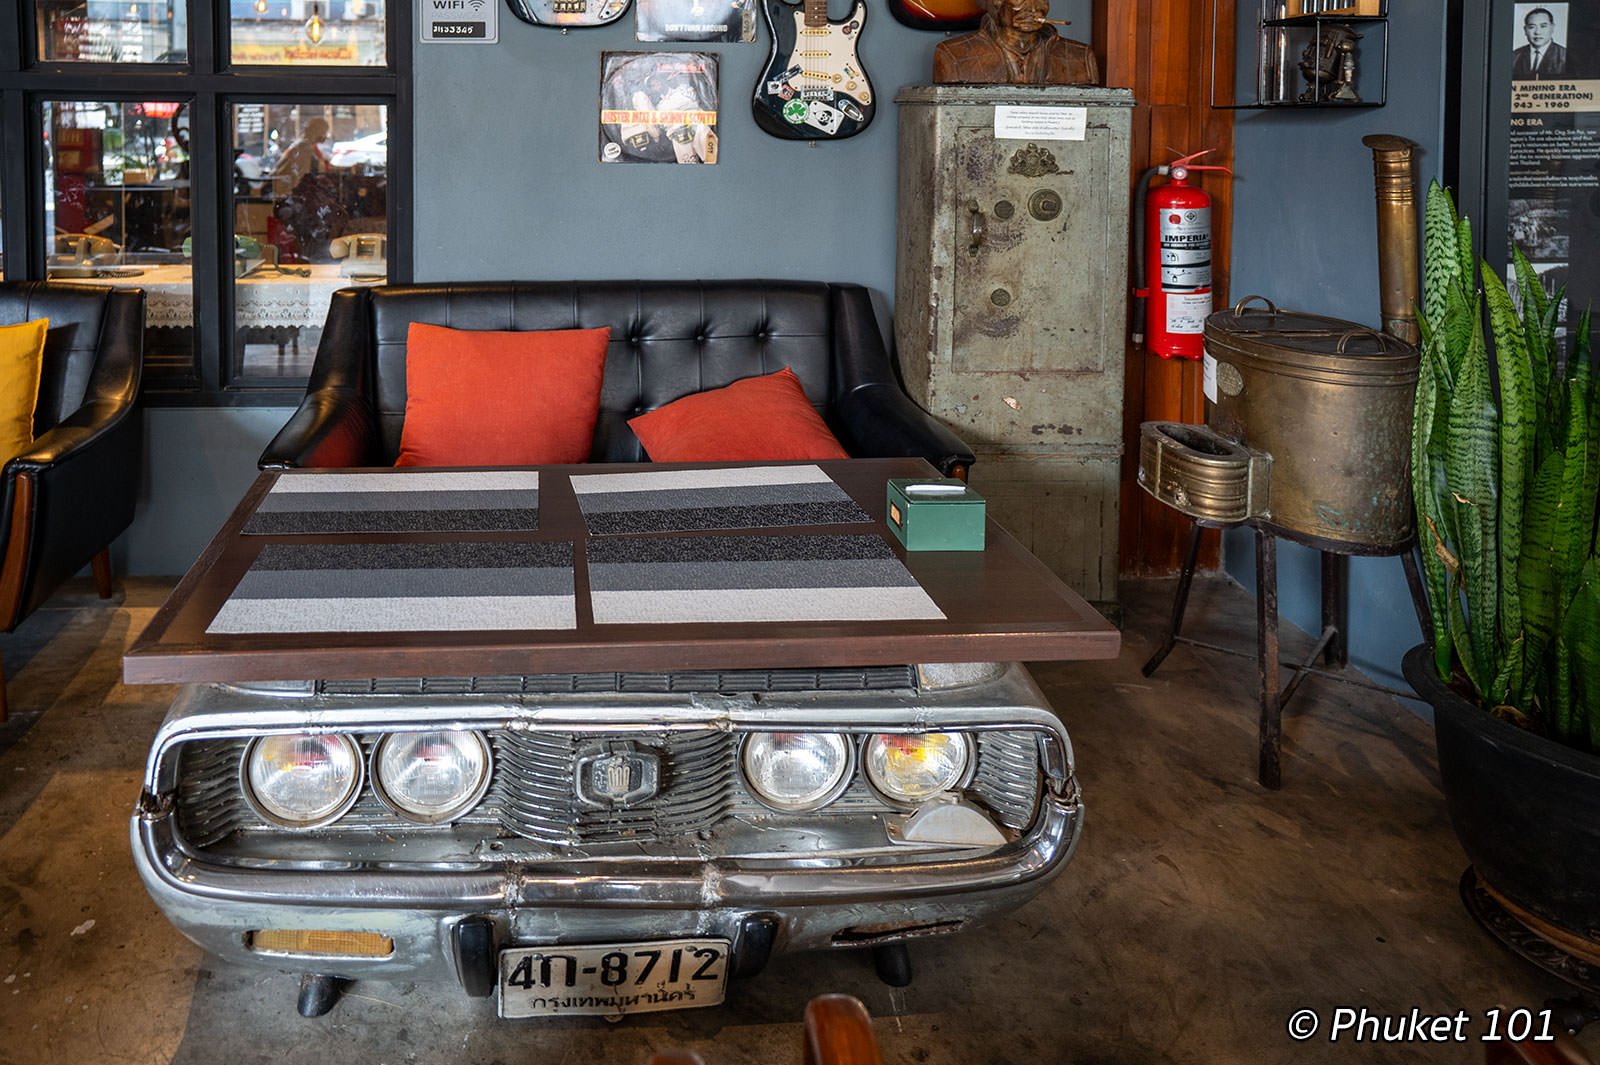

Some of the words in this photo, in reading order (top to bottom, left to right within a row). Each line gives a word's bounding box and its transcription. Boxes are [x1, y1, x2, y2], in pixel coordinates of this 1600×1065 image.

[433, 0, 464, 9] WIFI
[1532, 92, 1593, 100] GENERATION)
[603, 111, 630, 123] MISTER
[1510, 118, 1524, 126] NG
[1526, 118, 1543, 126] ERA
